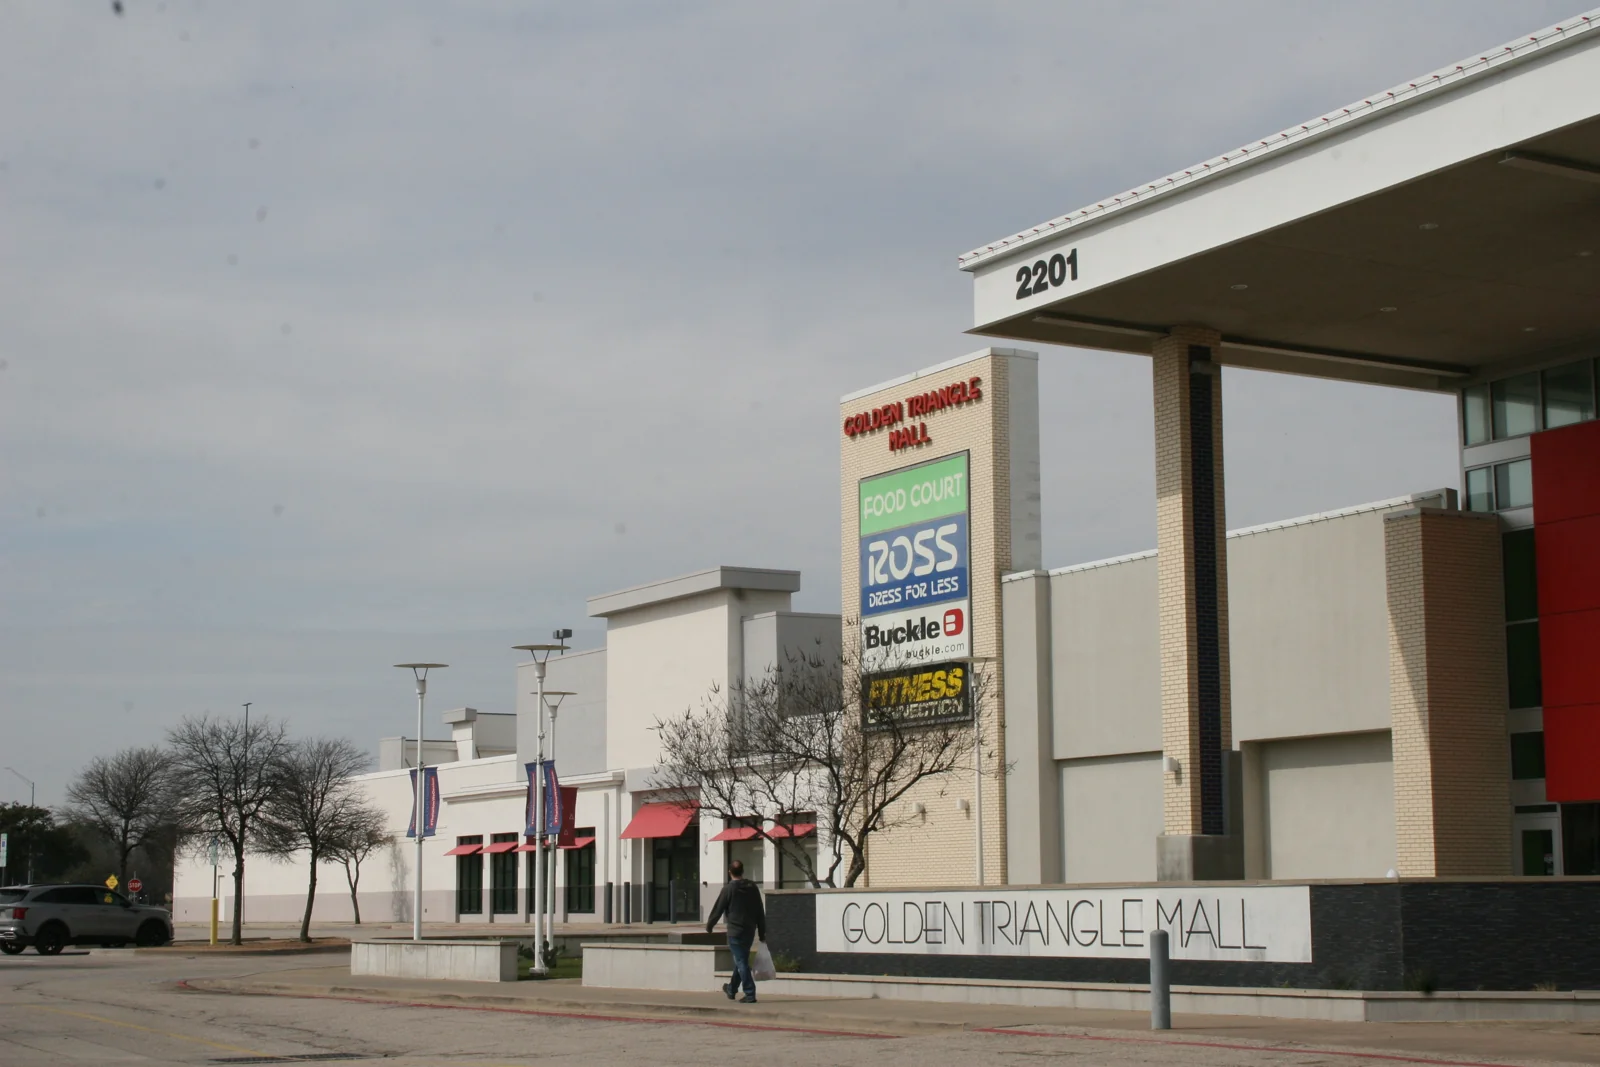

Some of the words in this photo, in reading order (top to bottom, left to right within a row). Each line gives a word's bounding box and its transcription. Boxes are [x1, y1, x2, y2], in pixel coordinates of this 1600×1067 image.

[1016, 248, 1078, 300] 2201
[844, 401, 903, 437] GOLDEN
[905, 376, 981, 418] TRIANGLE
[889, 422, 932, 451] MALL
[863, 488, 906, 519] FOOD
[910, 473, 963, 507] COURT
[868, 523, 958, 586] ROSS
[869, 588, 901, 608] DRESS
[905, 582, 927, 600] FOR
[931, 576, 959, 596] LESS
[866, 616, 940, 650] Buckle
[906, 642, 965, 659] buckle.com
[867, 667, 964, 708] FITNESS
[842, 901, 964, 945] GOLDEN
[973, 899, 1144, 946] TRIANGLE
[1156, 898, 1267, 950] MALL
